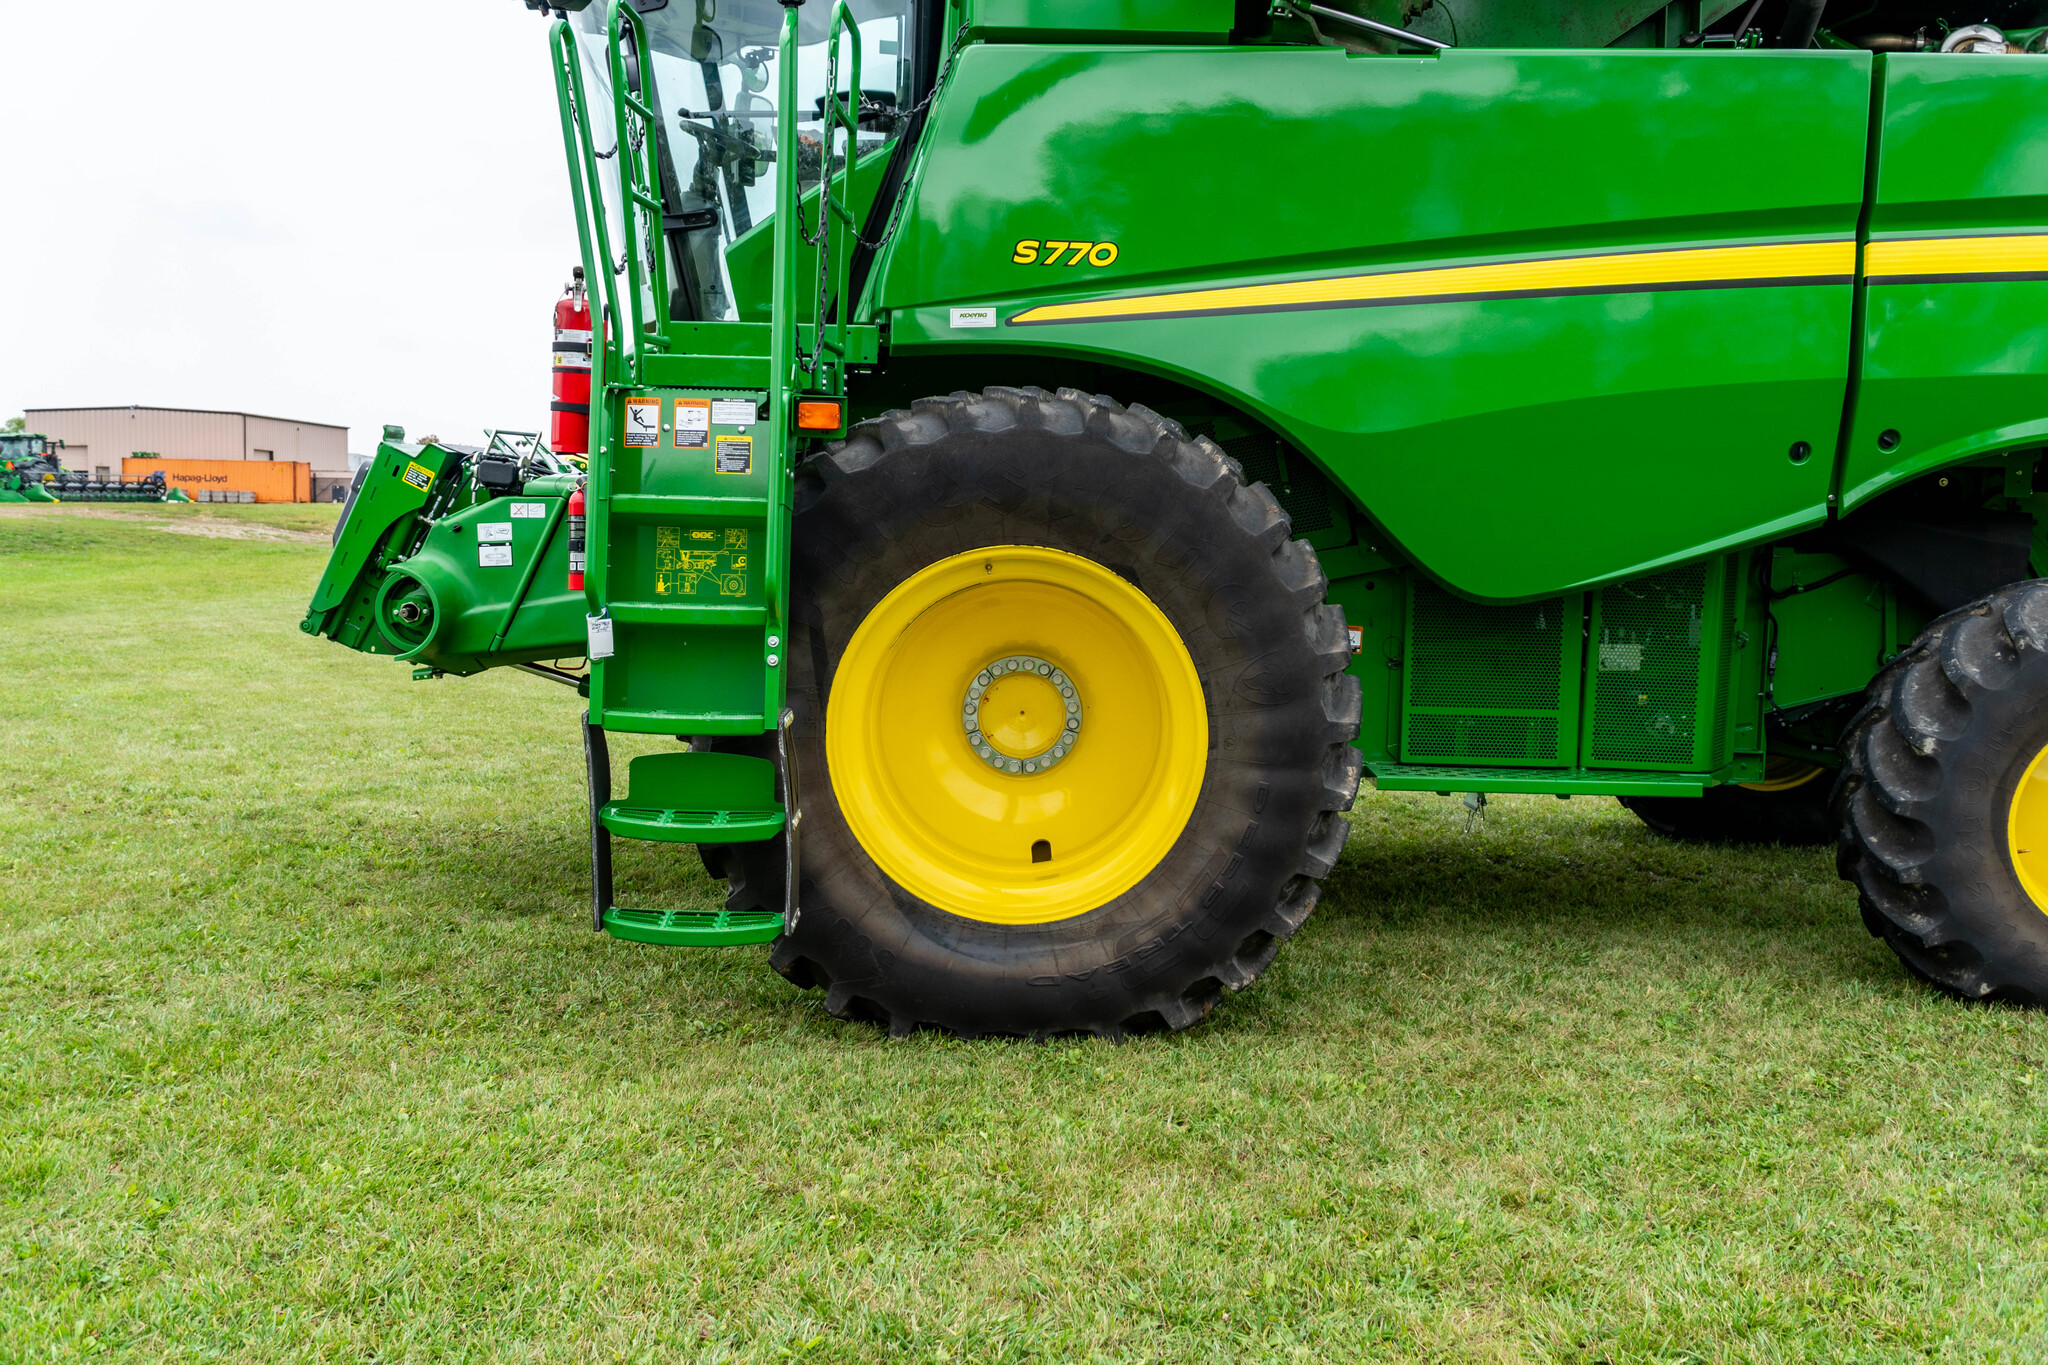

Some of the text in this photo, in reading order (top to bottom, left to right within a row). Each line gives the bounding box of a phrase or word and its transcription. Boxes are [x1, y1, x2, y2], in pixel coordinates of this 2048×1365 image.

[1011, 239, 1120, 268] S770
[172, 473, 228, 483] Hapag-Lloyd
[1026, 780, 1270, 987] DEEP TREAD
